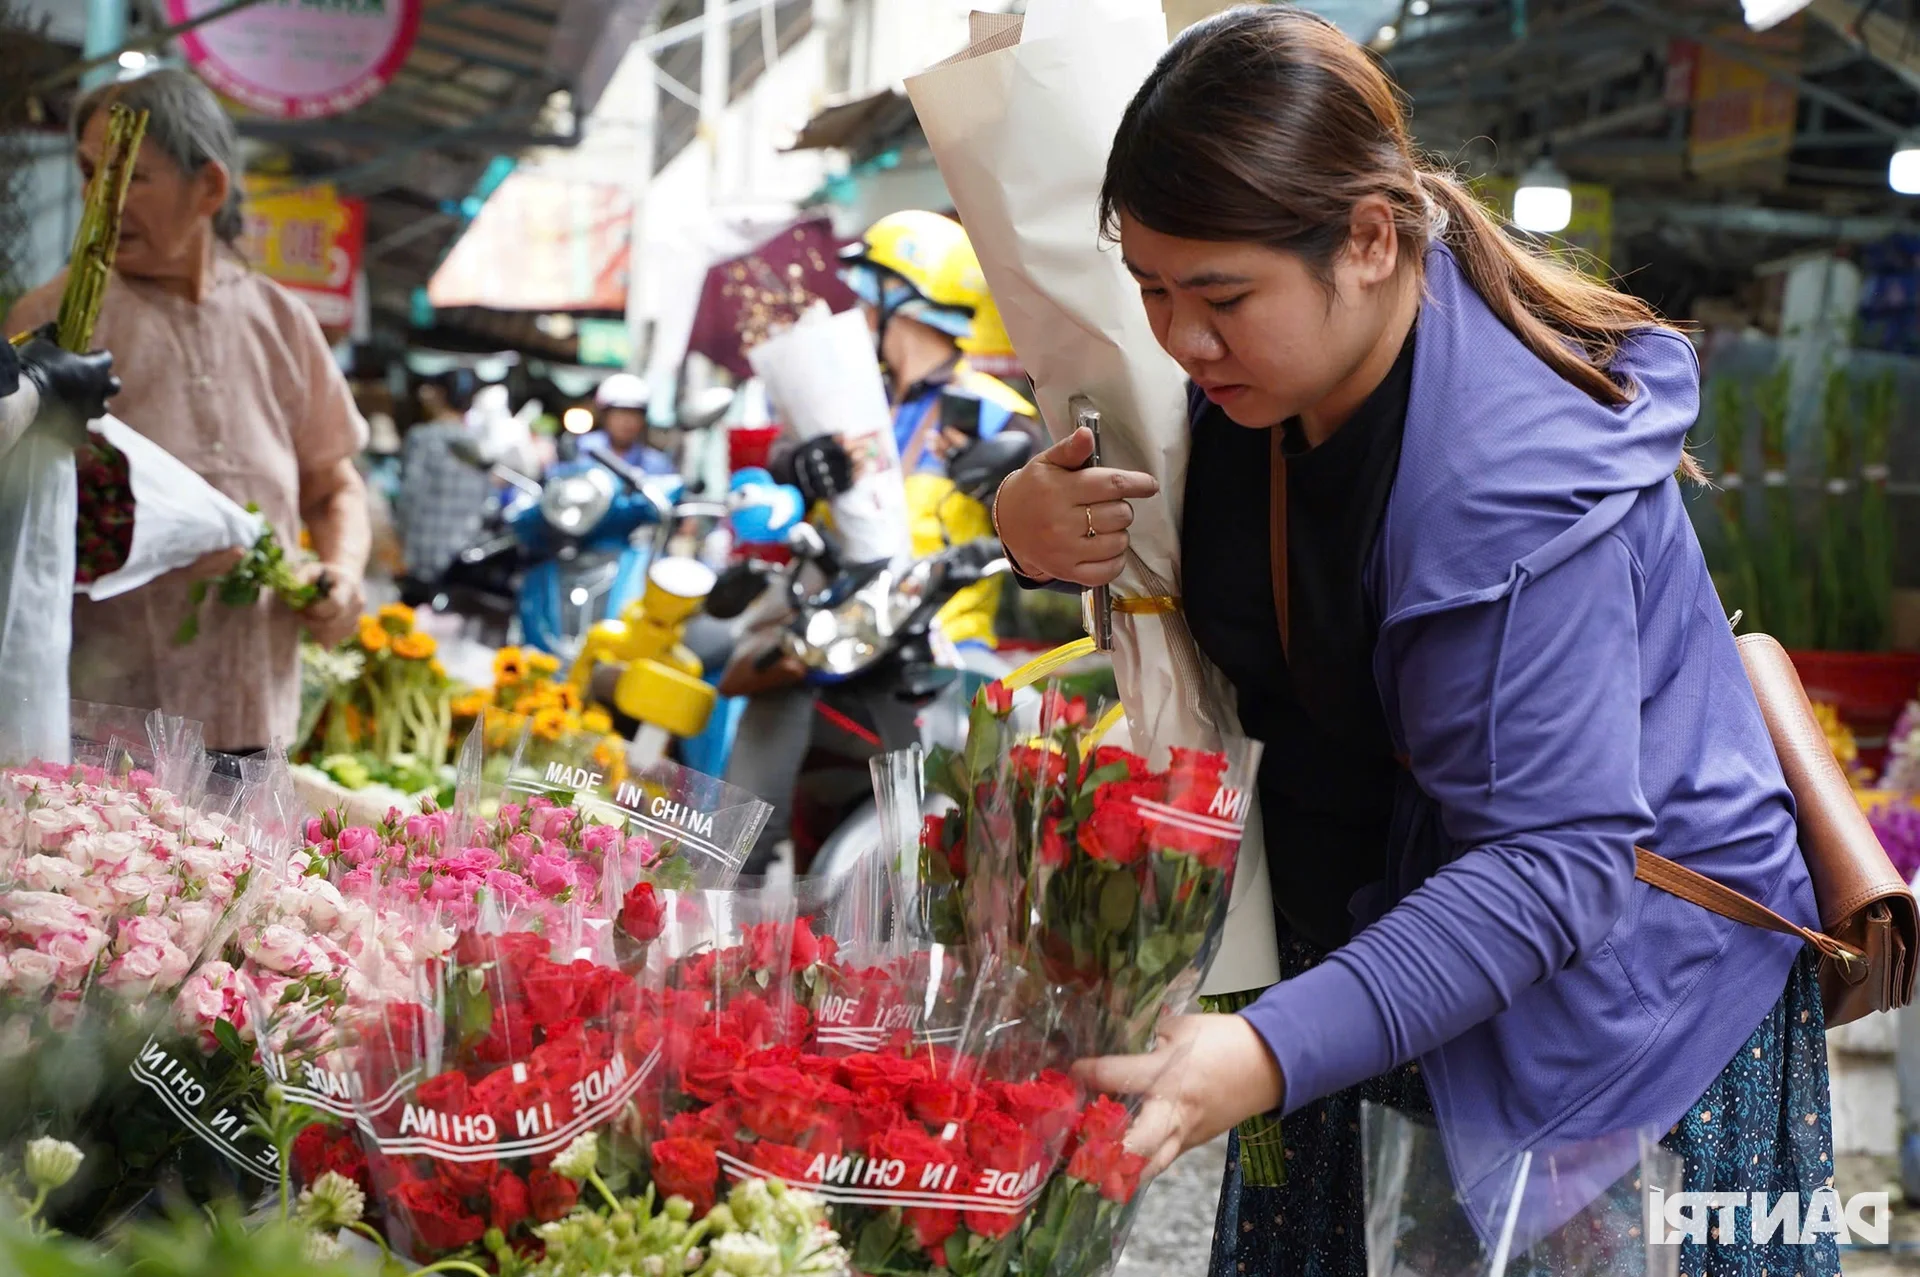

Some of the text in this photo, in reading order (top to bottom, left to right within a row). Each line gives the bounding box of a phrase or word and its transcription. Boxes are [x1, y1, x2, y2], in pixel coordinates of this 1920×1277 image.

[544, 761, 714, 838] MADE IN CHINA
